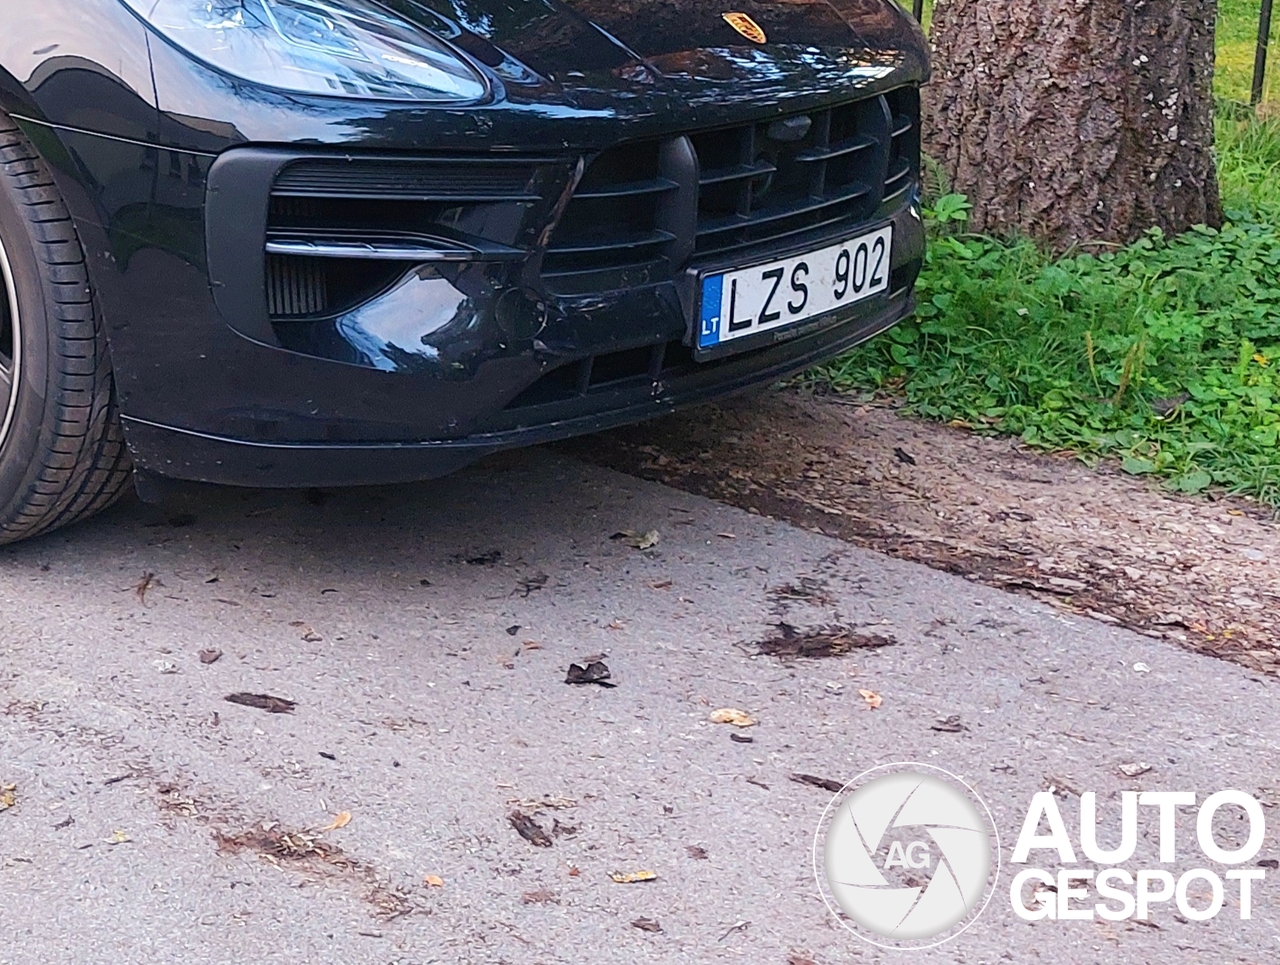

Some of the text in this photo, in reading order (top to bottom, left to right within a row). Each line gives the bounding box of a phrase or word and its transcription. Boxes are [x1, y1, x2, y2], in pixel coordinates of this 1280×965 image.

[728, 261, 809, 332] LZS
[833, 236, 885, 300] 902
[702, 317, 719, 335] LT
